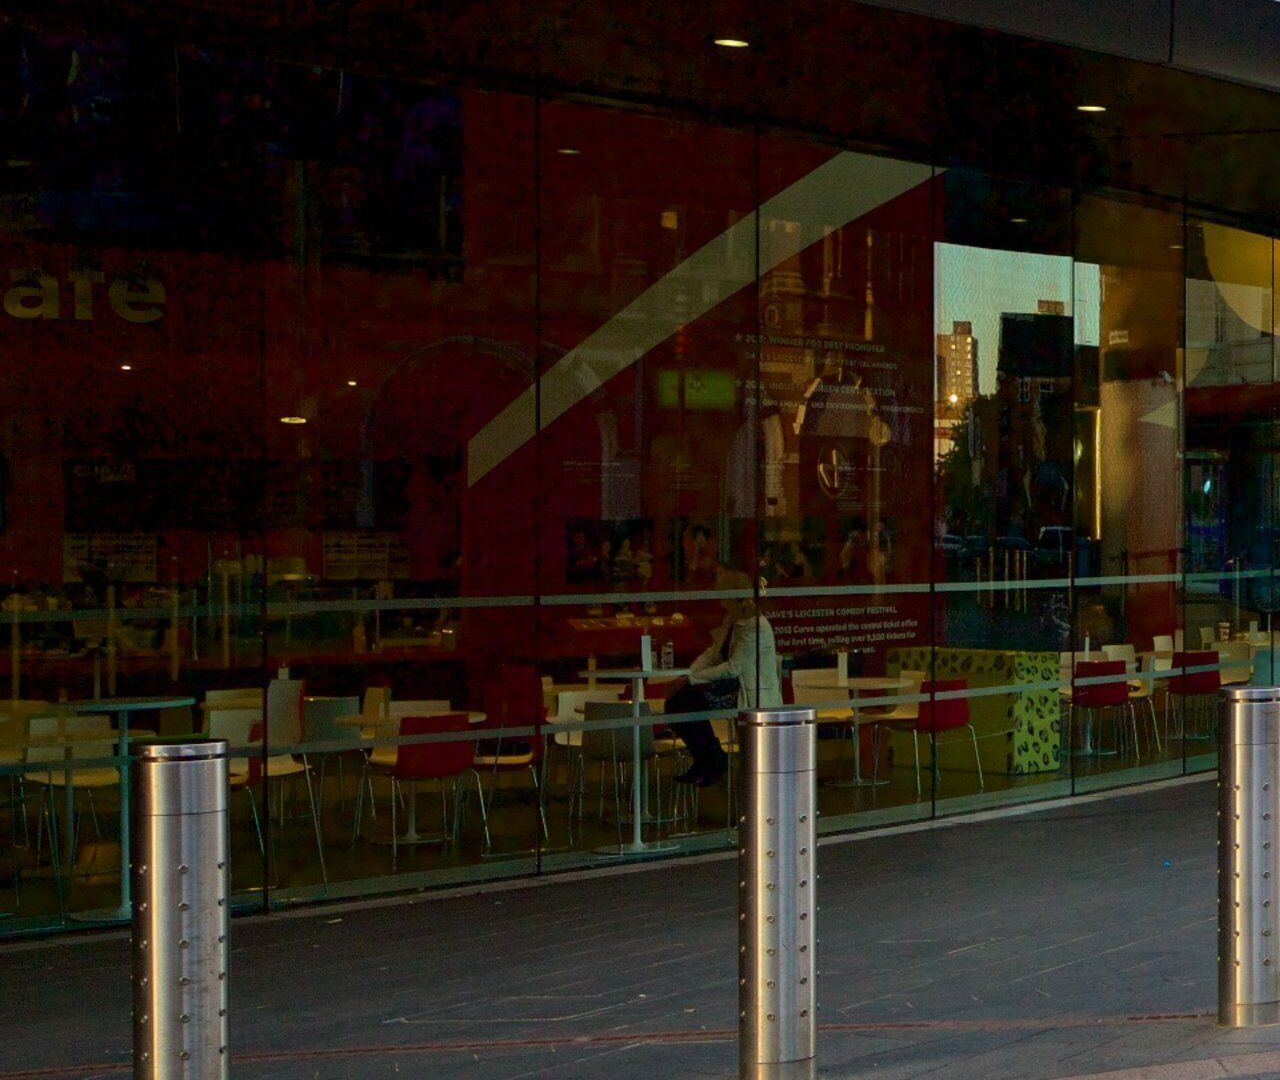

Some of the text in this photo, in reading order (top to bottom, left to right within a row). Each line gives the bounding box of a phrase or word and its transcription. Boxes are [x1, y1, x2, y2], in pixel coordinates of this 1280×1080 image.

[765, 605, 898, 620] DAVE'S LEICESTER COMEDY FESTIVAL
[793, 625, 814, 634] Curve
